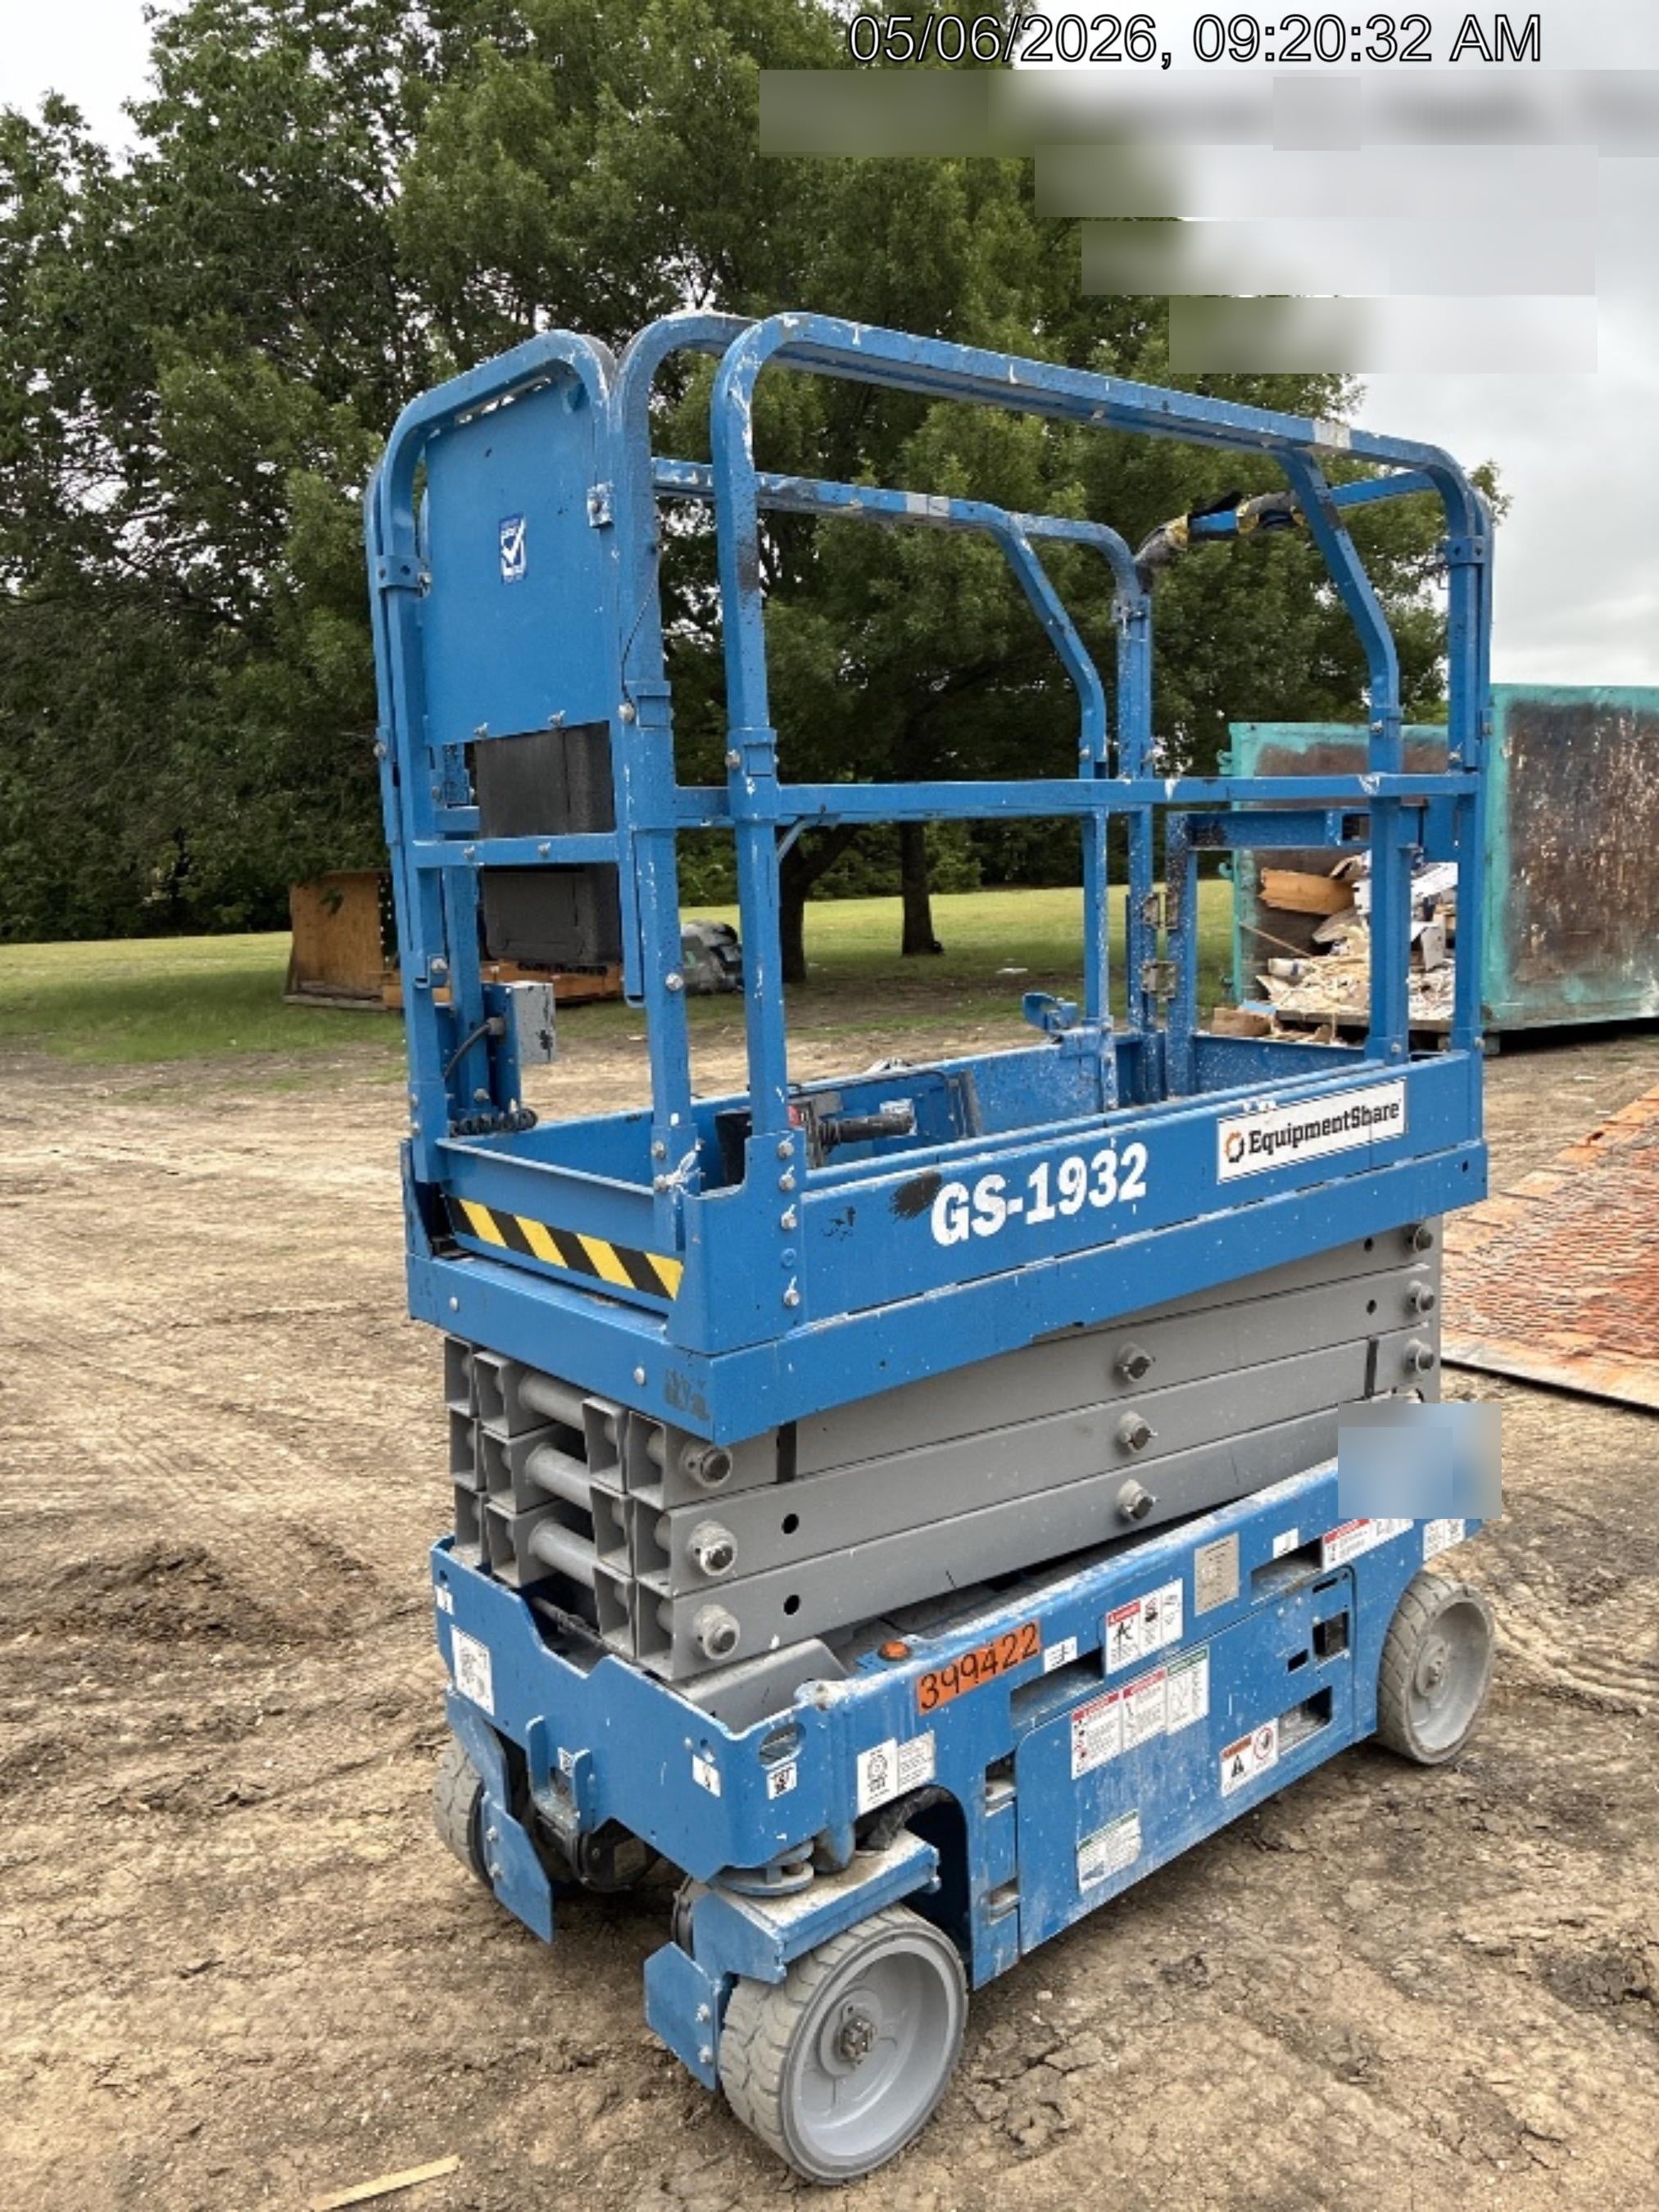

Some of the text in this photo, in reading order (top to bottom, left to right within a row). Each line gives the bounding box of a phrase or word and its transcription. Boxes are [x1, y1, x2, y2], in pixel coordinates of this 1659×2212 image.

[1248, 1102, 1399, 1156] EquipmentShare
[931, 1142, 1147, 1246] GS-1932
[921, 1621, 1038, 1709] 399422
